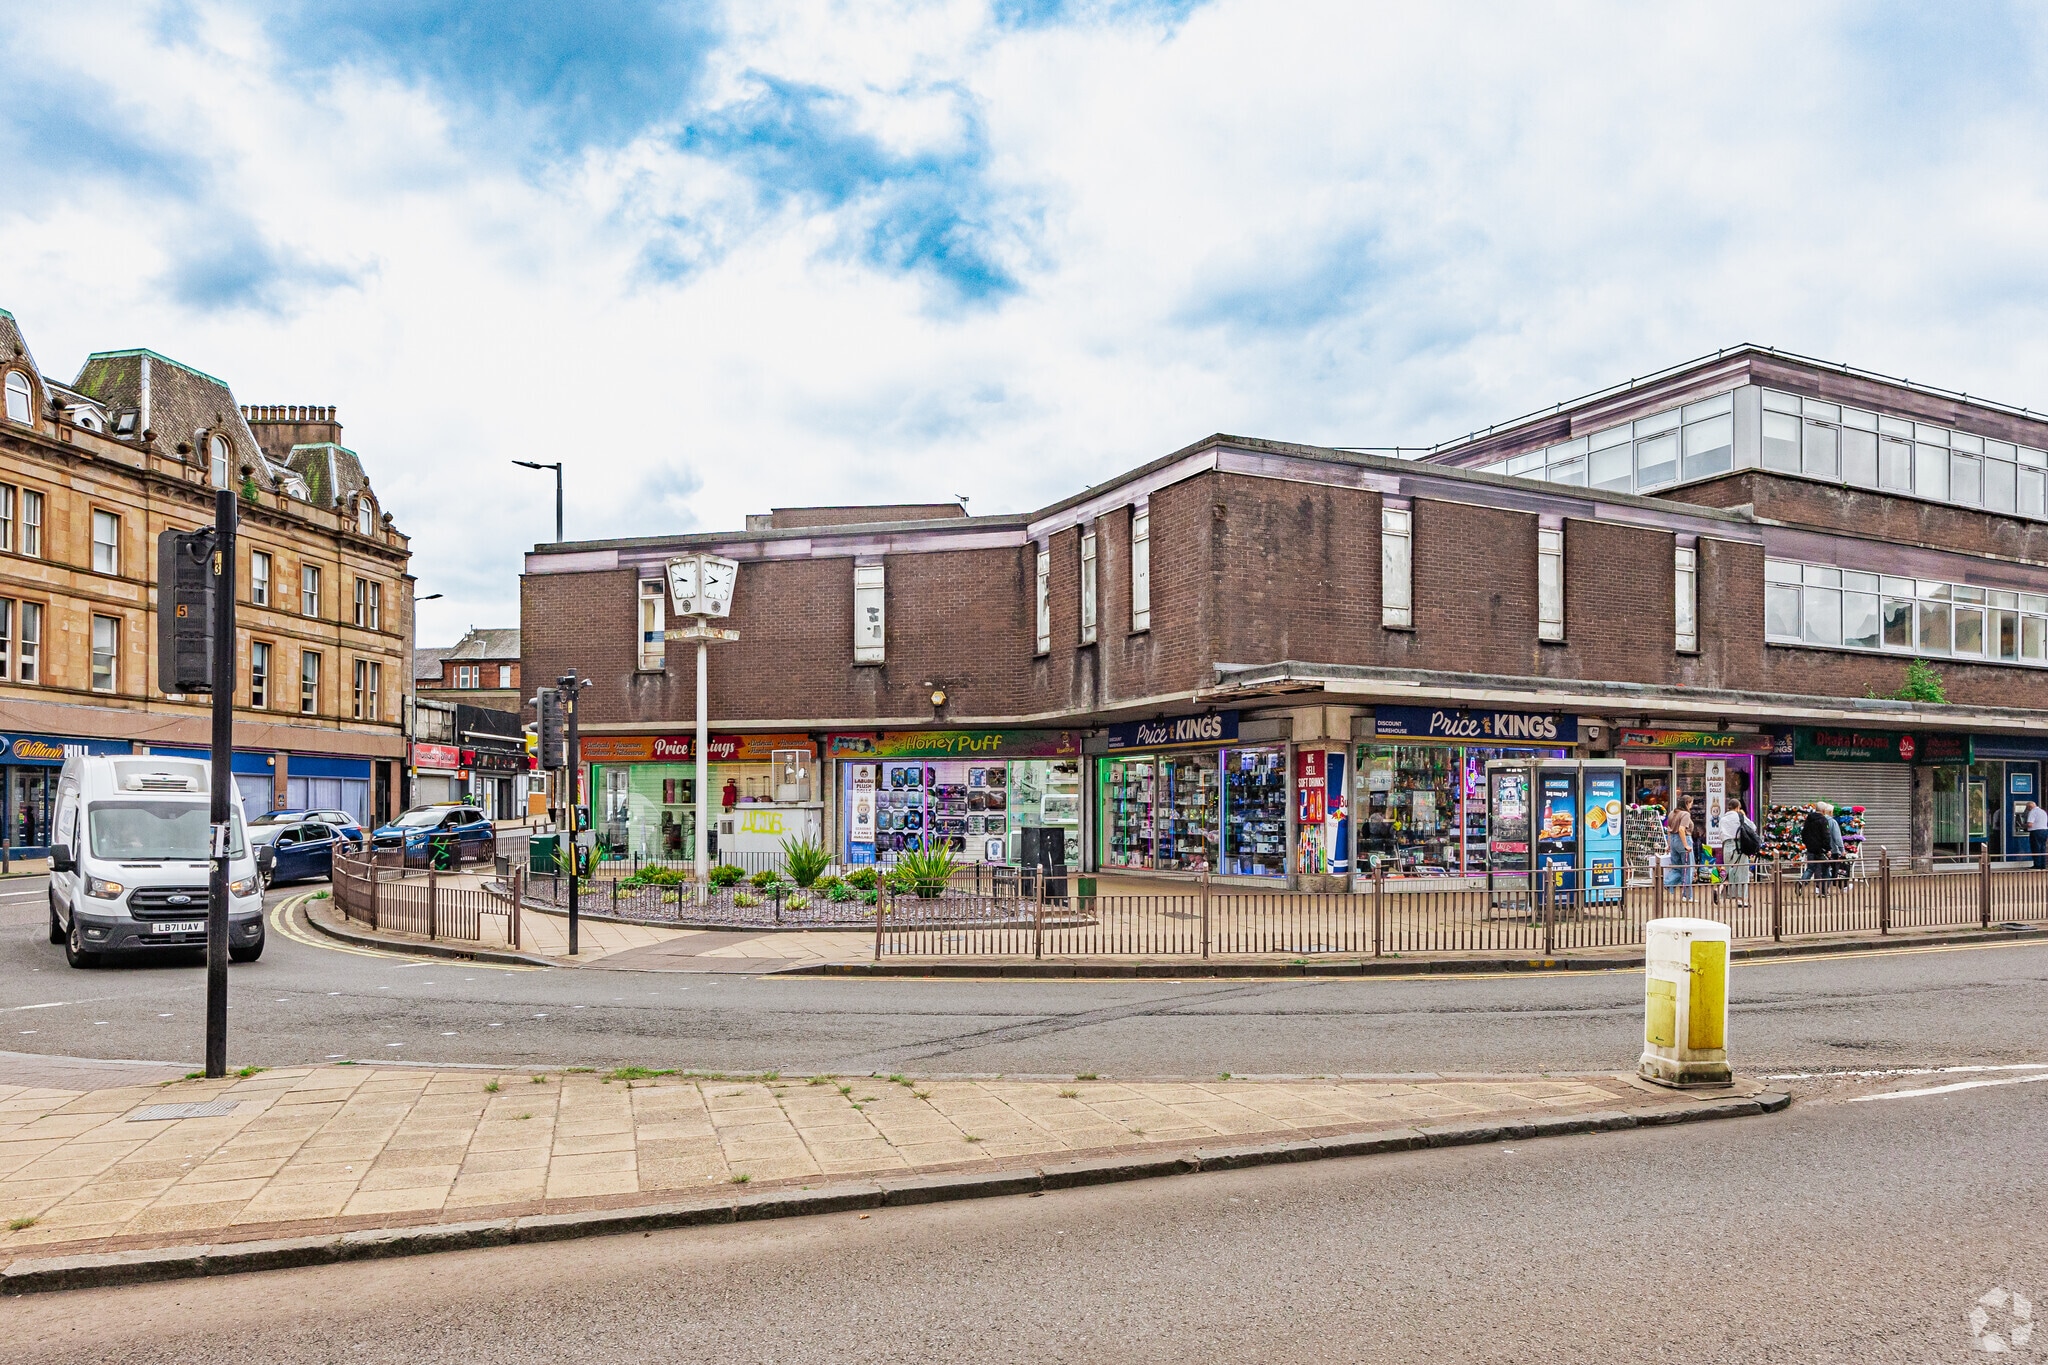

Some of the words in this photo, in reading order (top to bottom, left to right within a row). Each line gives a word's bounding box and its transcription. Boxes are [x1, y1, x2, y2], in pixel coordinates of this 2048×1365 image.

[179, 605, 186, 617] 5
[1136, 723, 1167, 744] Price
[1176, 715, 1222, 740] KINGS
[1429, 711, 1480, 736] Price
[1494, 714, 1557, 738] KINGS
[906, 735, 955, 752] Honey
[957, 734, 1003, 751] Puff
[1664, 734, 1700, 746] Honey
[1703, 736, 1735, 747] Puff
[13, 739, 65, 760] William
[64, 744, 89, 758] HILL
[654, 739, 688, 755] Price
[707, 740, 735, 758] ings
[1307, 753, 1315, 764] WE
[1306, 766, 1316, 776] SELL
[1298, 778, 1308, 788] SOFT
[1309, 777, 1324, 787] DRINKS
[158, 924, 179, 932] LB71
[181, 923, 199, 931] UAV
